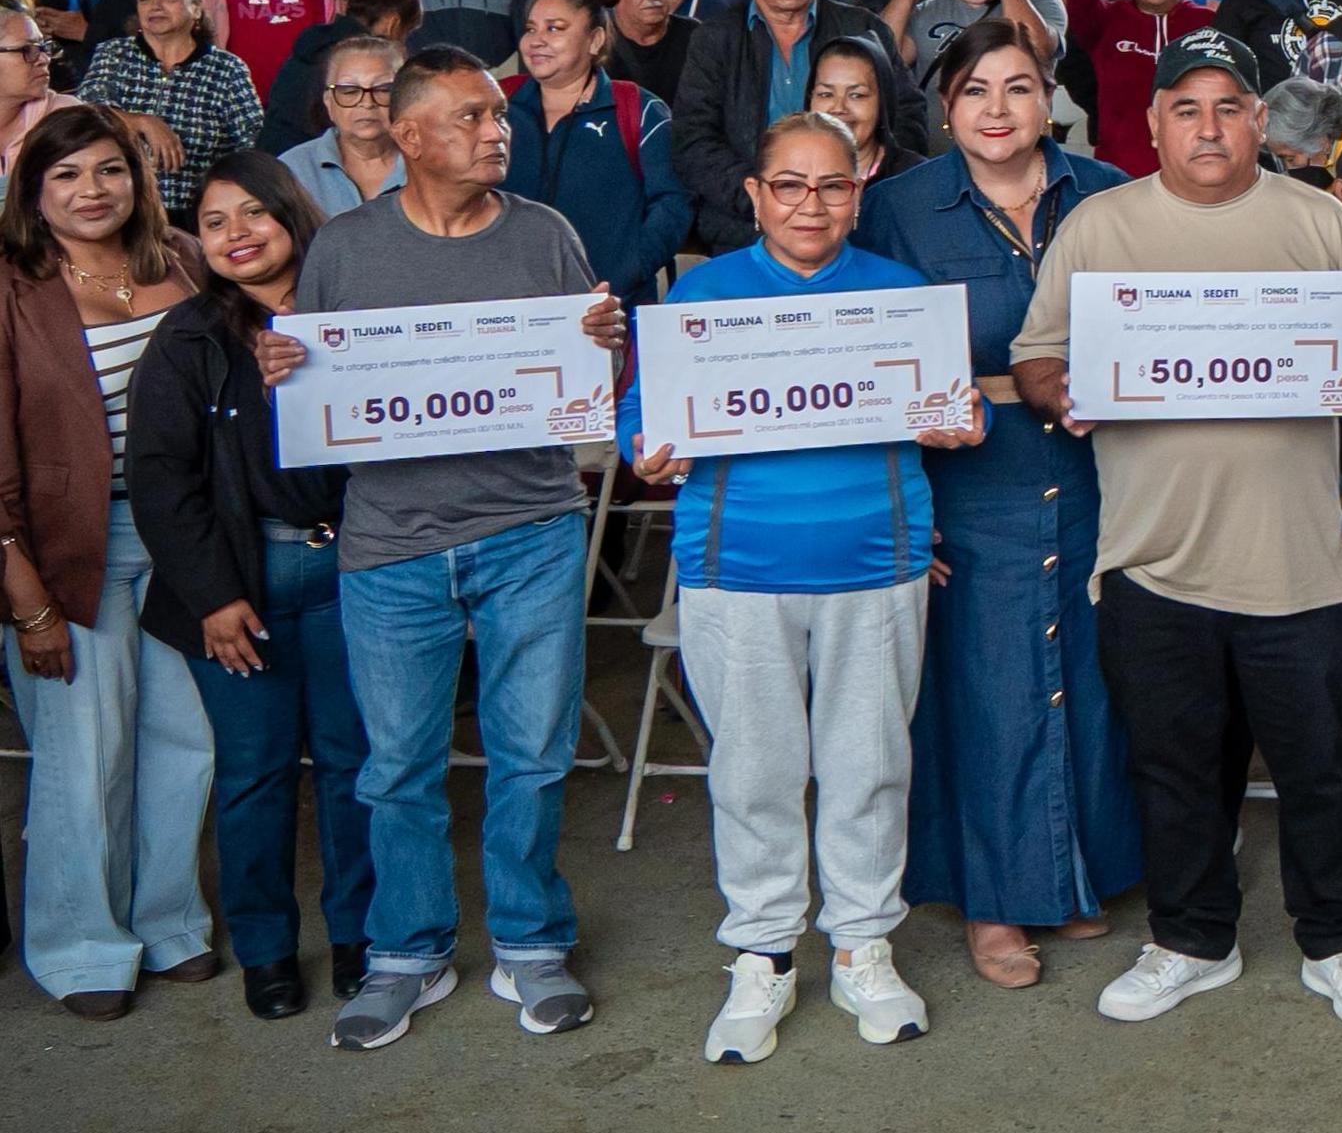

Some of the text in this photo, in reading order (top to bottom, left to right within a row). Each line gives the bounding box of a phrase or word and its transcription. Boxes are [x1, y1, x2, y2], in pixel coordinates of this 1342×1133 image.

[1145, 289, 1192, 298] TIJUANA
[1203, 288, 1239, 298] SEDETI
[1261, 287, 1298, 295] FONDOS
[835, 306, 874, 317] FONDOS
[475, 315, 515, 325] FONDOS
[715, 315, 764, 328] TIJUANA
[775, 311, 813, 324] SEDETI
[353, 325, 403, 337] TIJUANA
[415, 320, 452, 333] SEDETI
[1276, 374, 1309, 384] pesos
[858, 396, 892, 409] pesos
[498, 403, 532, 415] pesos
